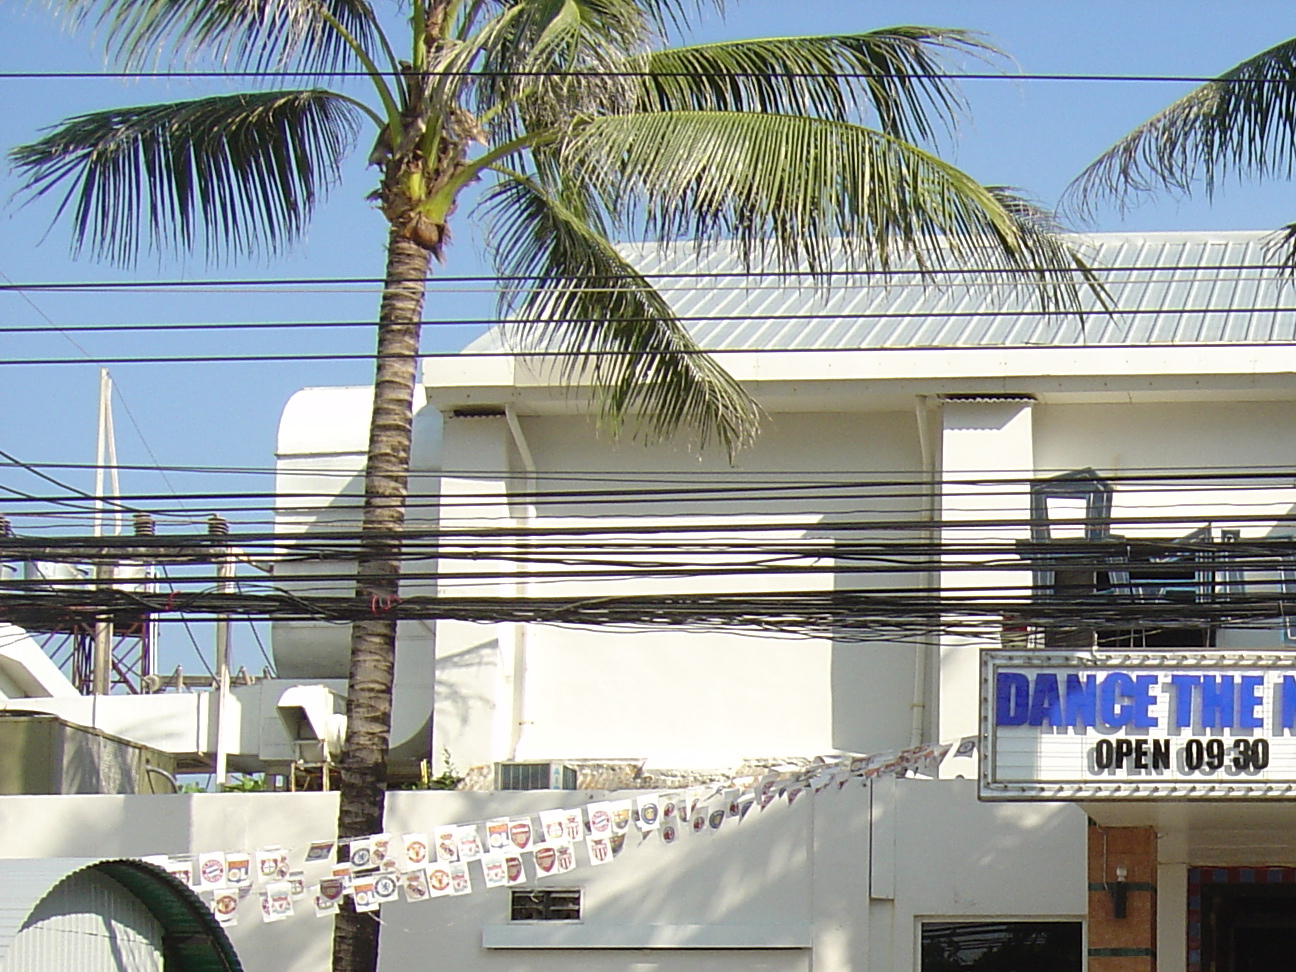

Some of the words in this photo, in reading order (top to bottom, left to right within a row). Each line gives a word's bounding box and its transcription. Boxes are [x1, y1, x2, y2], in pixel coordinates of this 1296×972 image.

[996, 672, 1158, 728] DANCE
[1171, 674, 1264, 729] THE
[1095, 738, 1170, 769] OPEN
